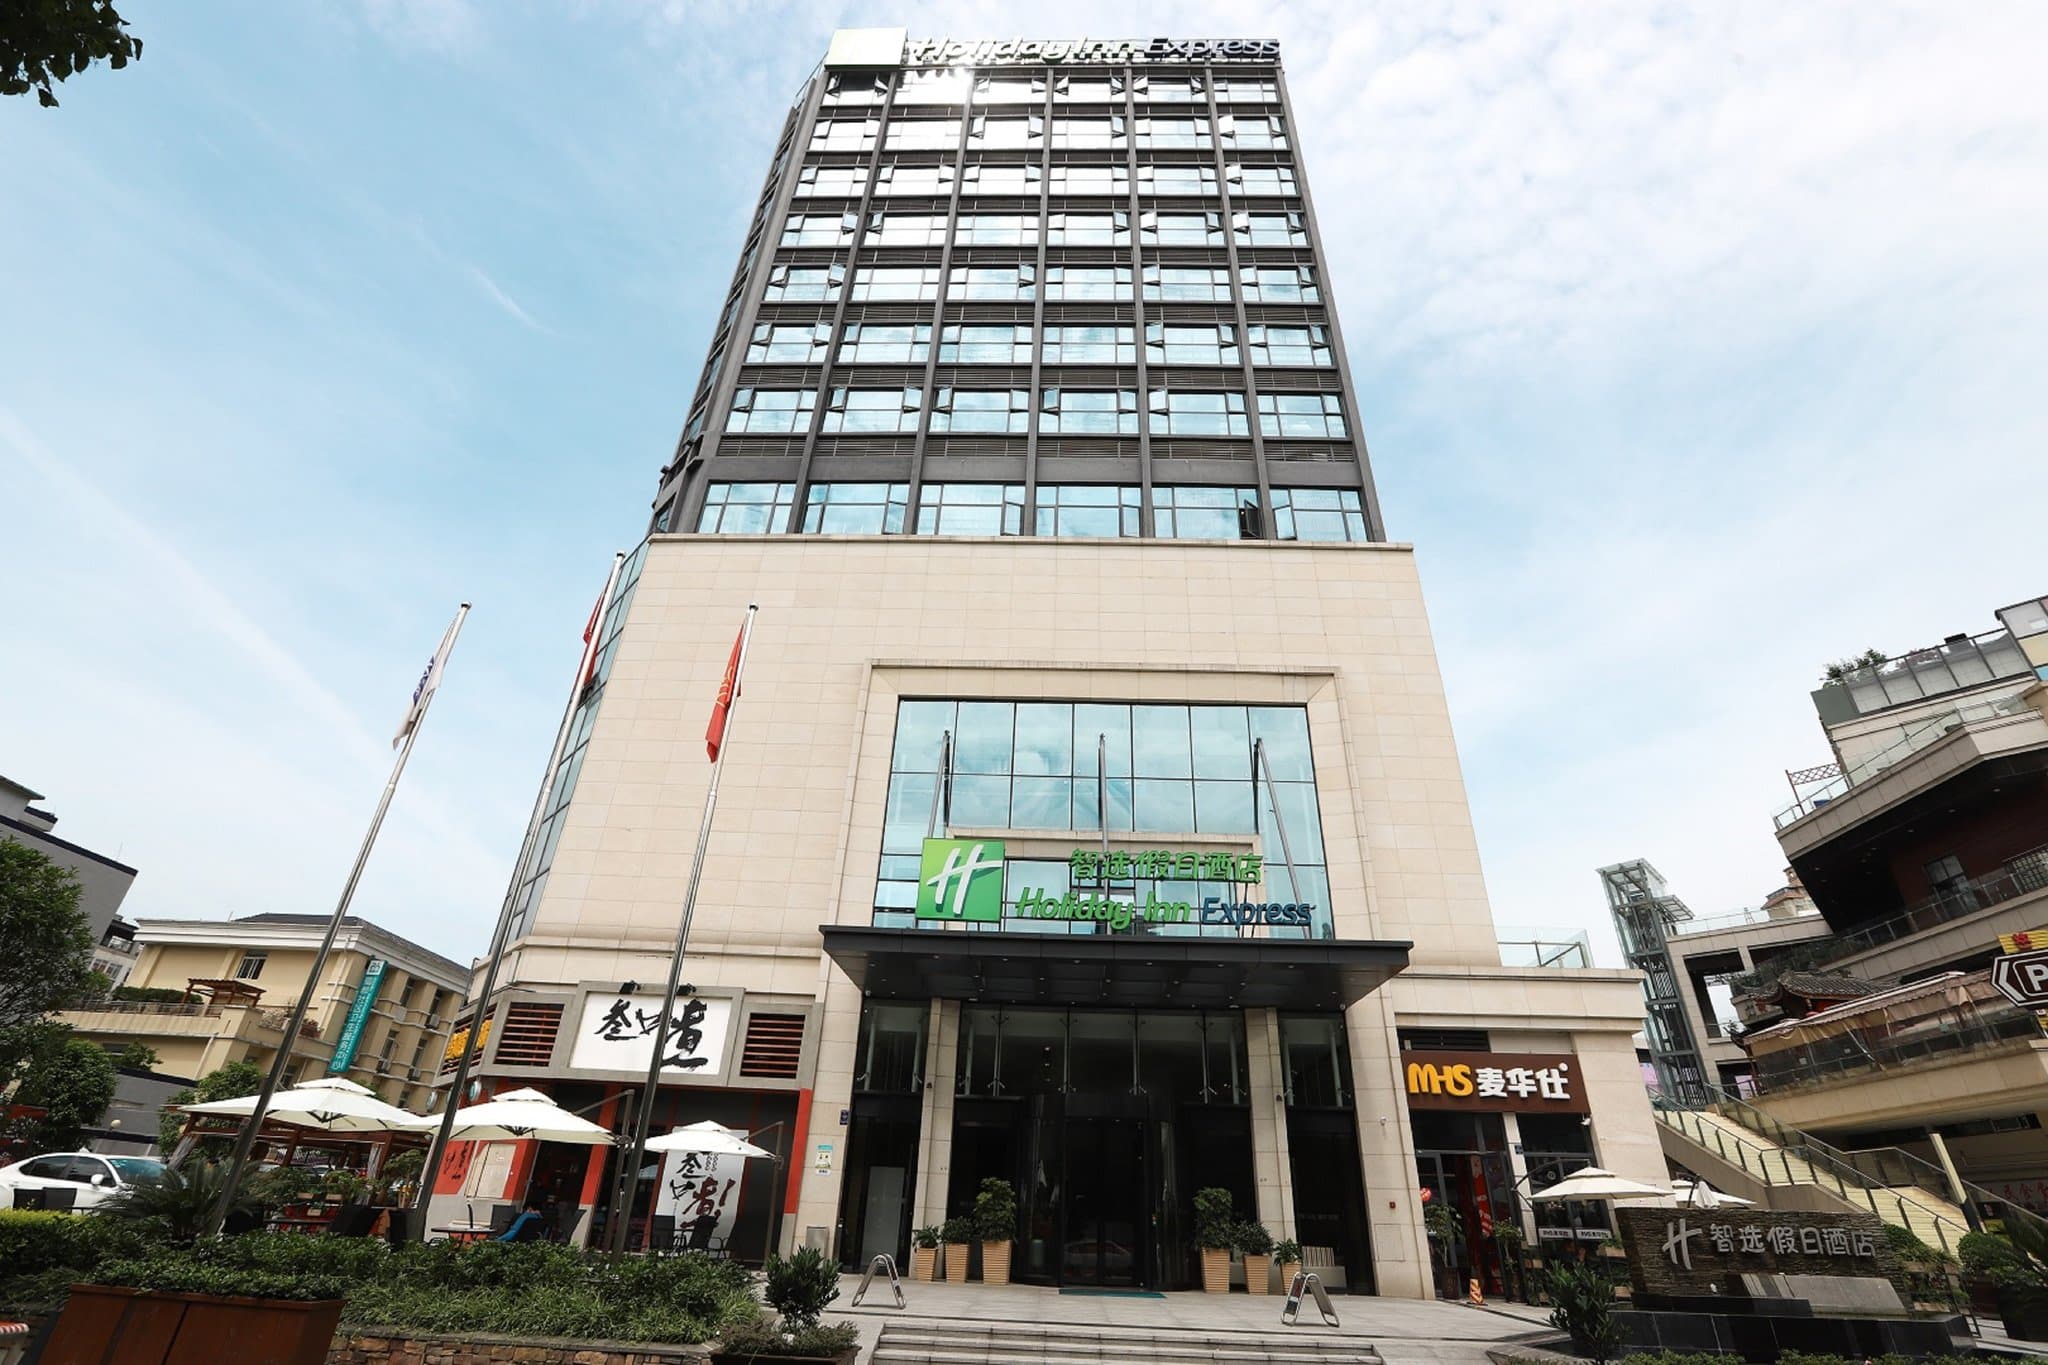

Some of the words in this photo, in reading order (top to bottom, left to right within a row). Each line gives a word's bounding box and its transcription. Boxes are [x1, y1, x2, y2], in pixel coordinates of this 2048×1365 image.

[908, 36, 1077, 64] Holiday
[1076, 36, 1134, 59] Inn
[1143, 37, 1280, 59] Express
[1069, 848, 1263, 883] 智选假日酒店
[1015, 886, 1134, 930] Holiday
[1143, 891, 1190, 922] Inn
[1201, 897, 1312, 930] Express
[2024, 964, 2048, 992] P
[1407, 1062, 1473, 1097] MHS
[1475, 1066, 1571, 1100] 麦华仕
[1710, 1223, 1876, 1257] 智选假日酒店
